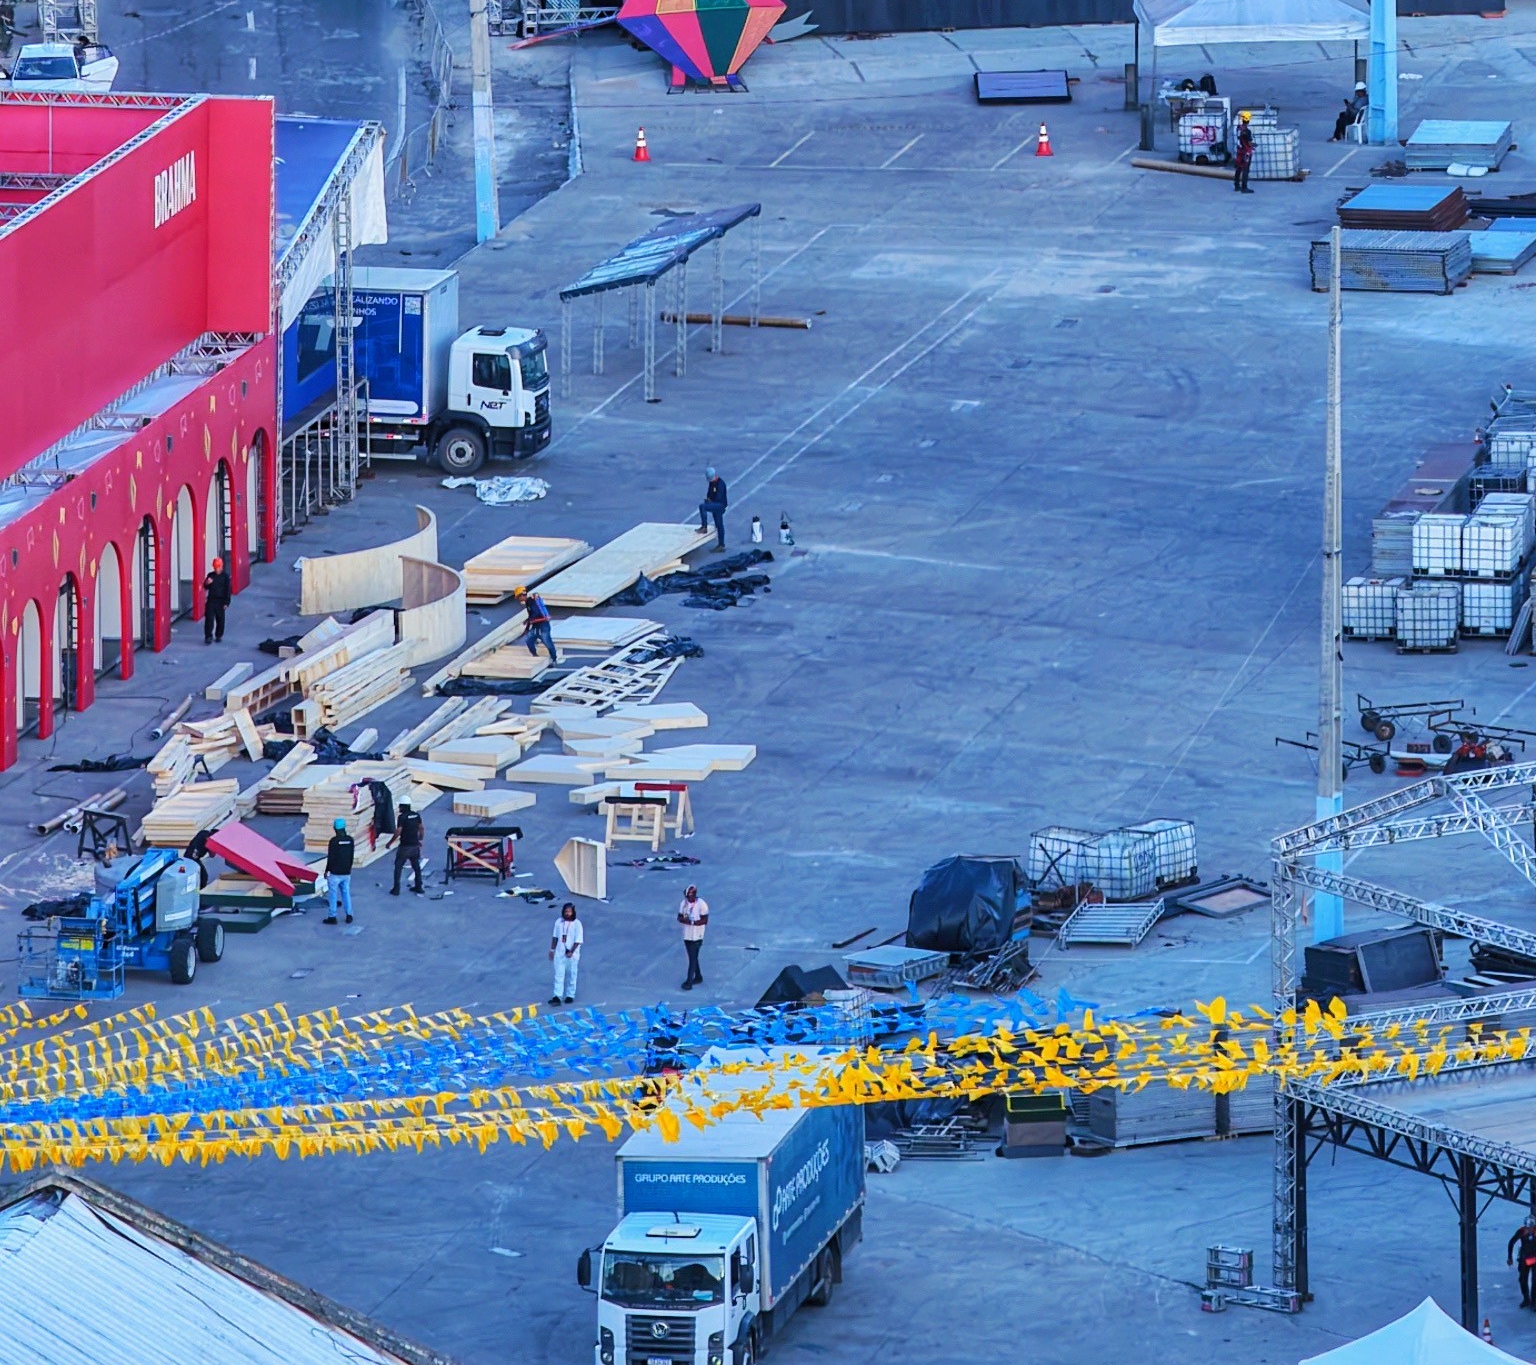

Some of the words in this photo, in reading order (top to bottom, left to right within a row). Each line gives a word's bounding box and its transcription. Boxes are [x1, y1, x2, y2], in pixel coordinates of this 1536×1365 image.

[154, 149, 197, 230] BRAHMA
[634, 1173, 669, 1184] GRUPO
[669, 1174, 692, 1184] ARTE
[692, 1173, 747, 1186] PRODUÇÕES
[796, 1137, 830, 1198] PRODUÇÕES
